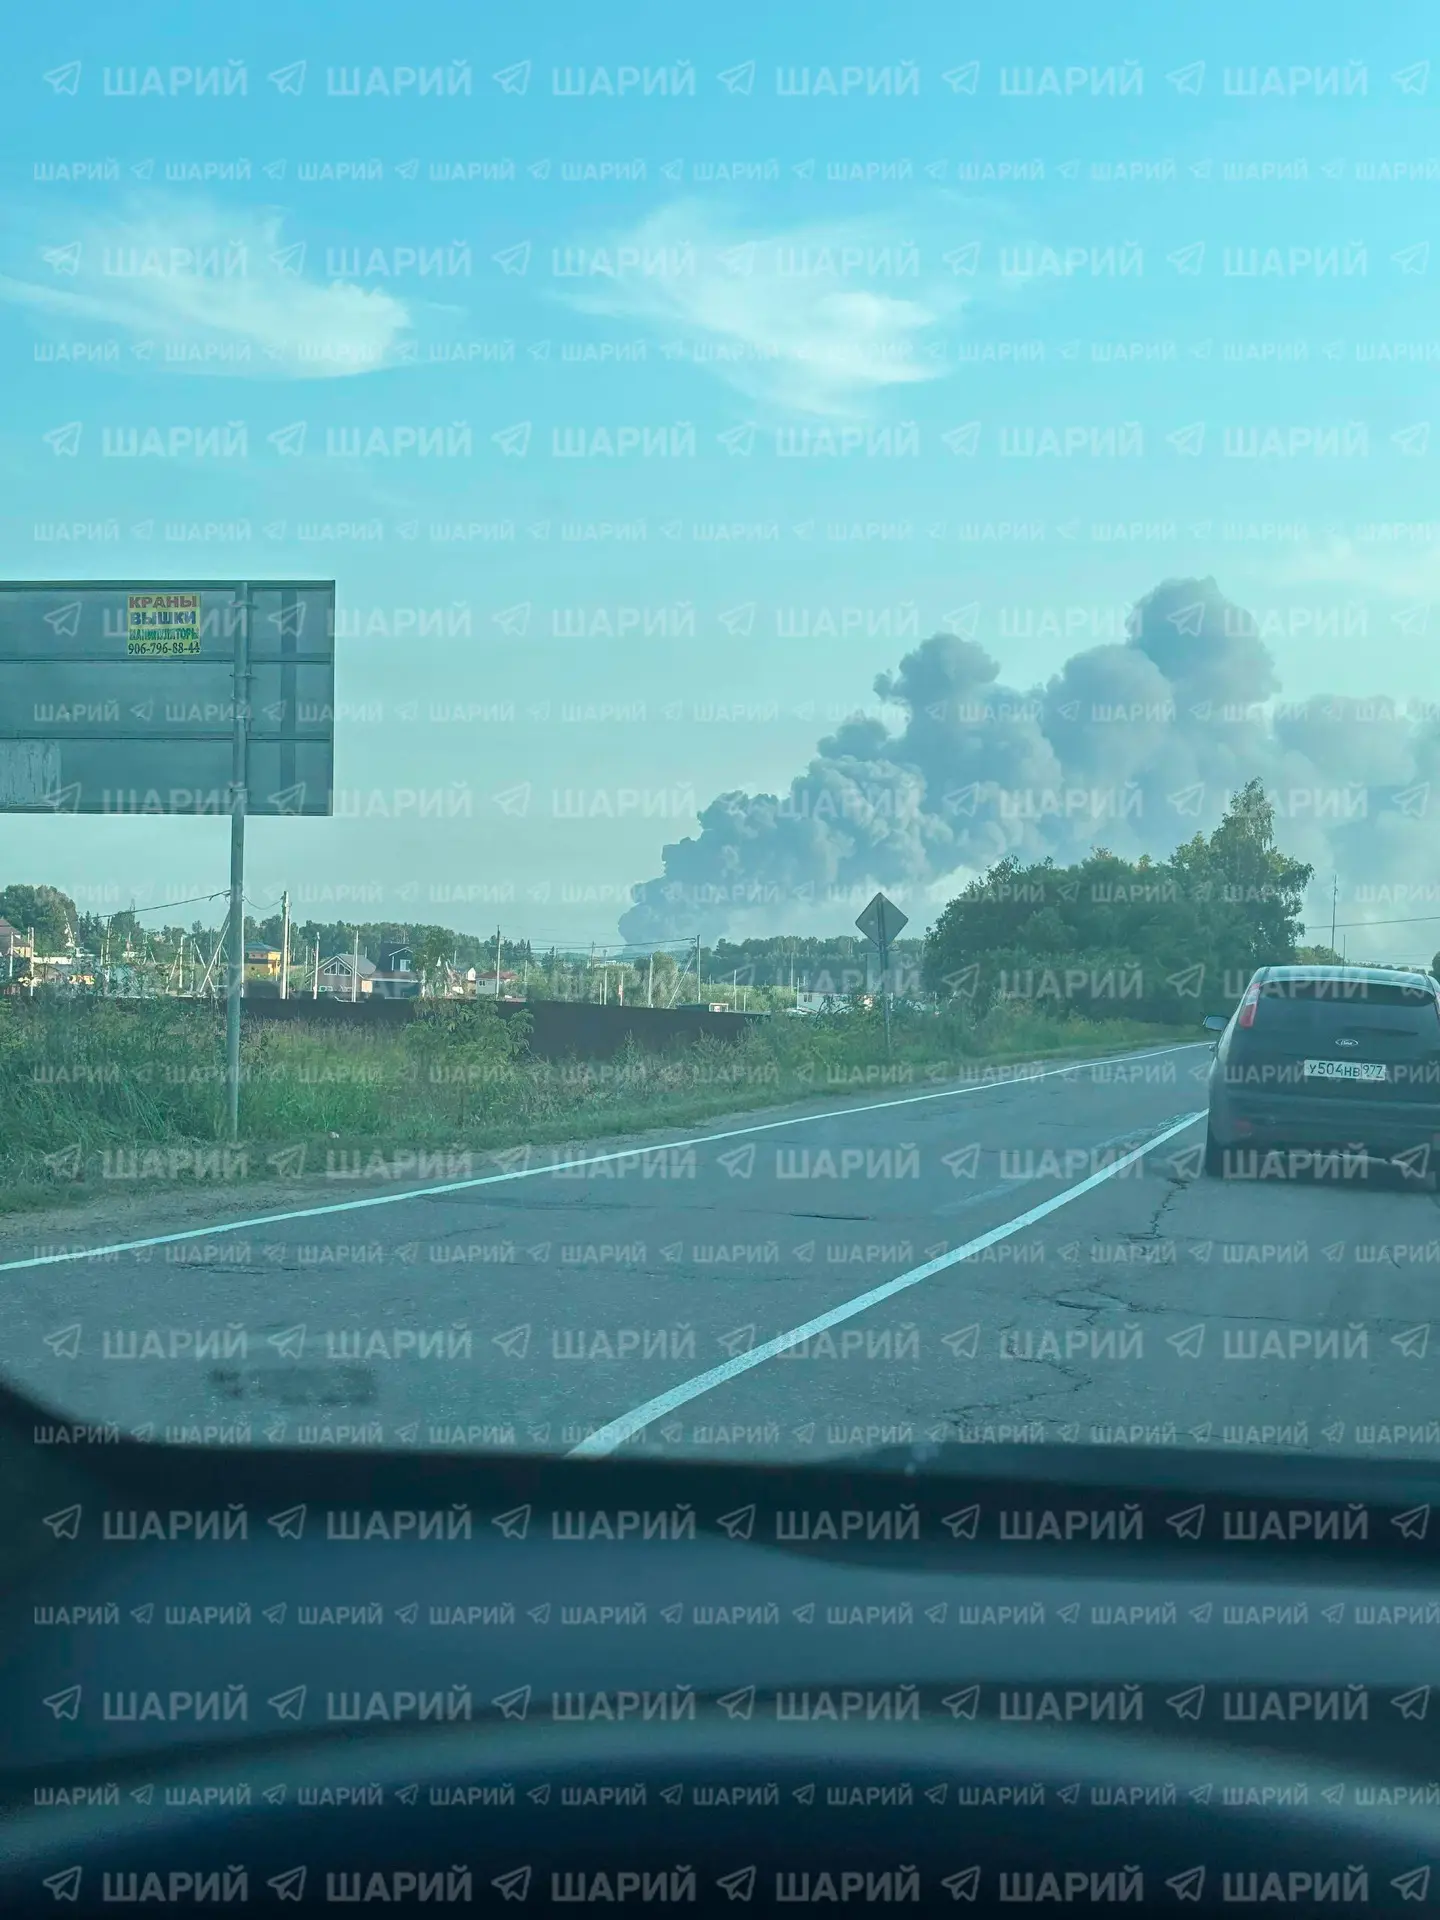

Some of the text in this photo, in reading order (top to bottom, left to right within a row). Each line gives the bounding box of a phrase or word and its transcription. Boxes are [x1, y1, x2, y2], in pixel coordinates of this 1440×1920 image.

[129, 596, 197, 608] КРАНЫ
[130, 611, 196, 625] ВЫШКИ
[128, 641, 200, 654] 906-796-88-44
